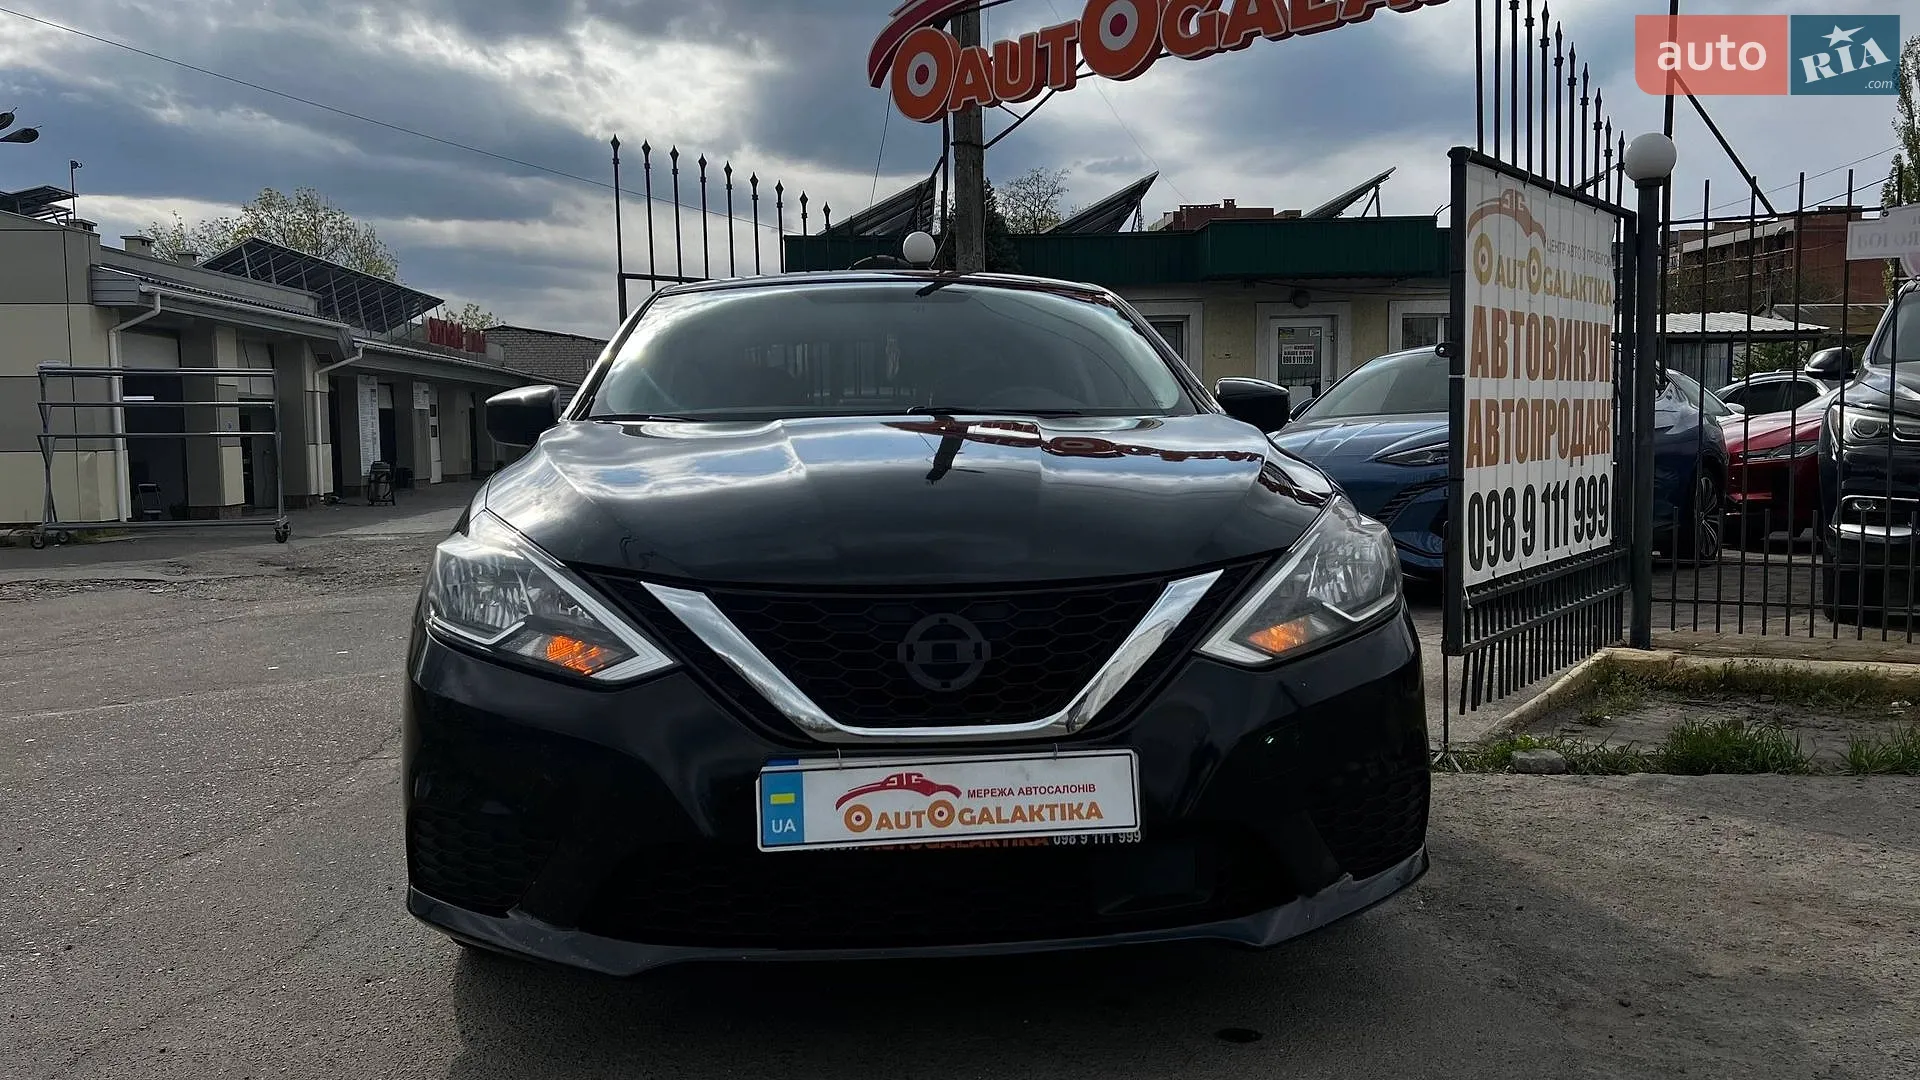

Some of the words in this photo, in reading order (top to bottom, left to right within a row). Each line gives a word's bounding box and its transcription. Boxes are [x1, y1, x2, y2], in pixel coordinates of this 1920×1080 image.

[1469, 304, 1611, 382] АВТОВИКУП
[1466, 397, 1611, 469] АВТОПРОДАЖ
[1468, 486, 1516, 572] 098
[1521, 483, 1536, 557] 9
[1541, 479, 1569, 552] 111
[1574, 473, 1609, 543] 999
[772, 818, 796, 833] UA
[967, 786, 1015, 799] МЕРЕЖА
[1017, 783, 1096, 796] АВТОСАЛОНІВ
